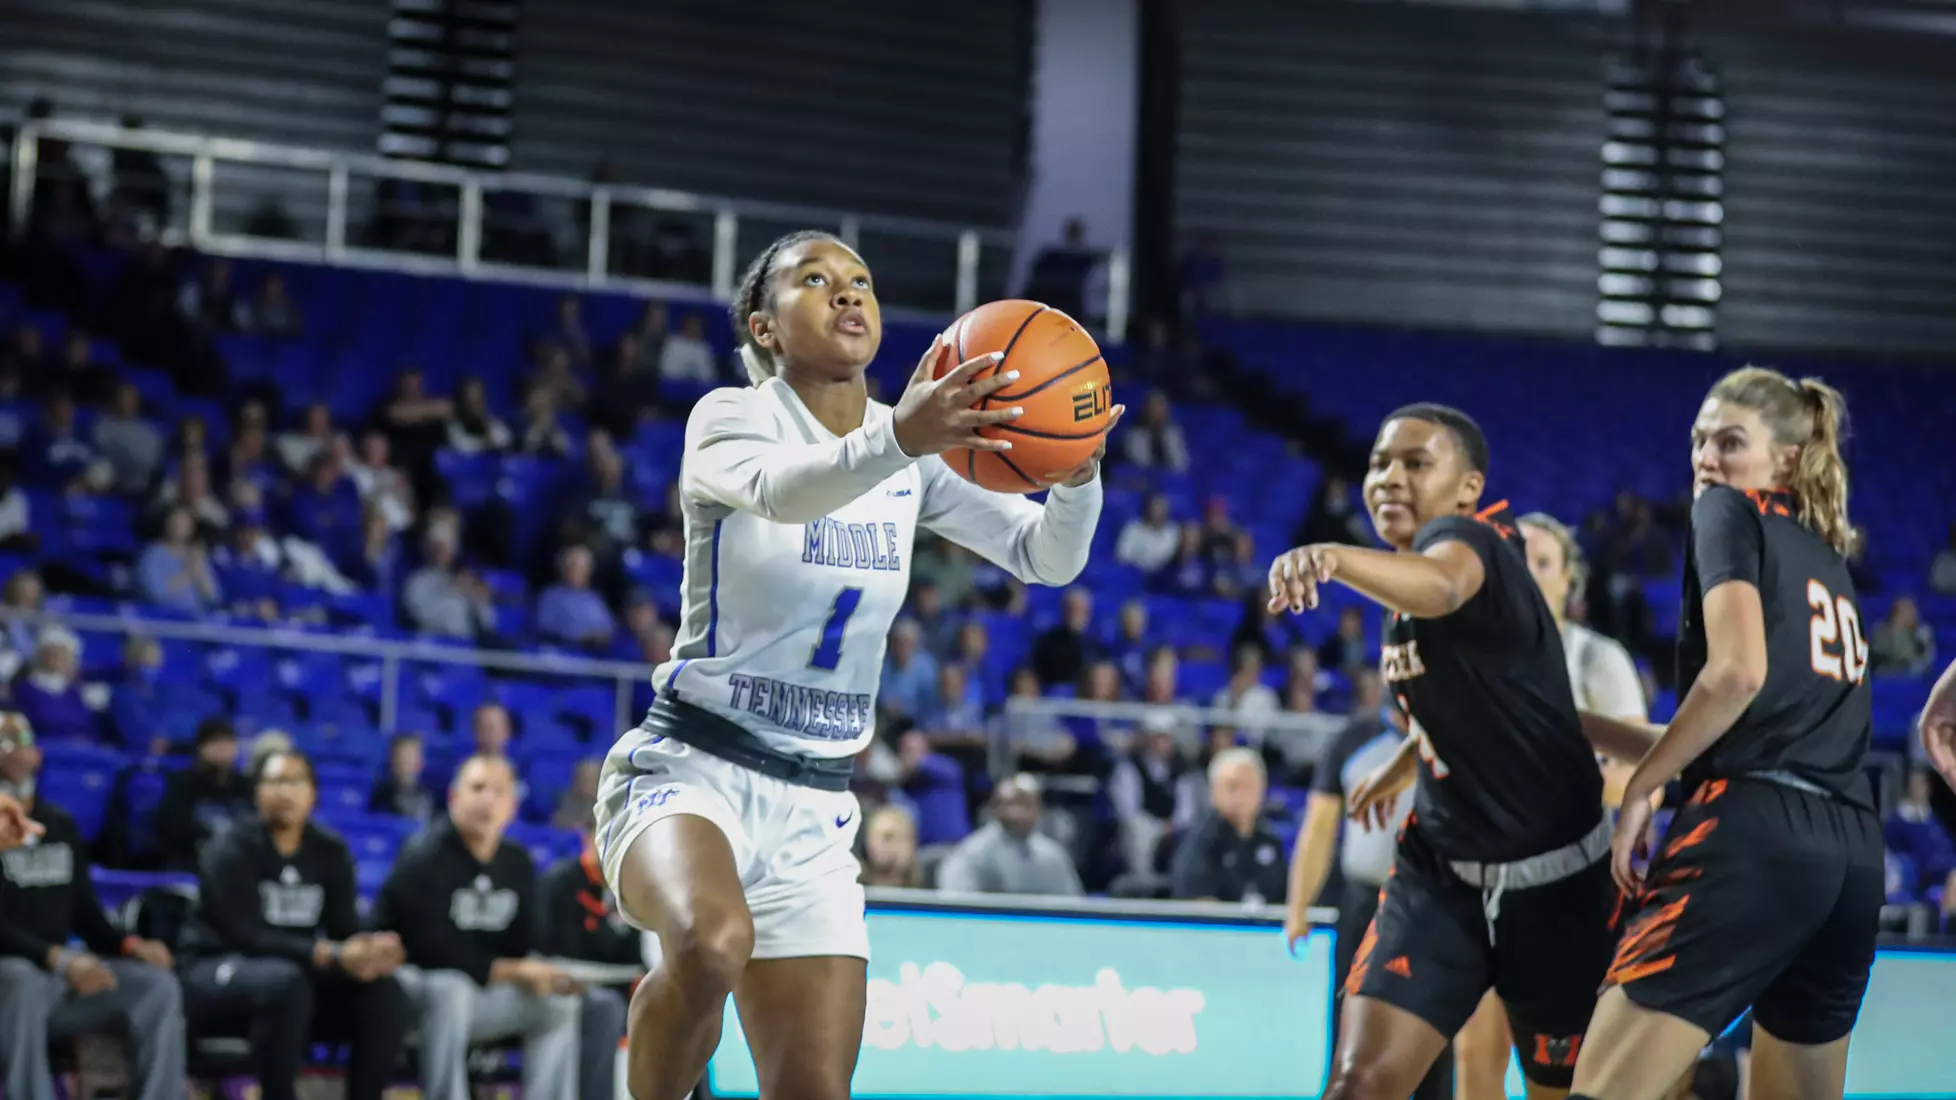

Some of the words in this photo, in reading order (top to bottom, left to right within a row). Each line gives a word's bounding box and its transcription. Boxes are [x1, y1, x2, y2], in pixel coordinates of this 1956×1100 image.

[801, 515, 900, 571] MIDDLE
[806, 585, 864, 671] 1
[1806, 578, 1869, 686] 20
[729, 672, 870, 741] TENNESSEE
[865, 961, 1206, 1055] etSmarter
